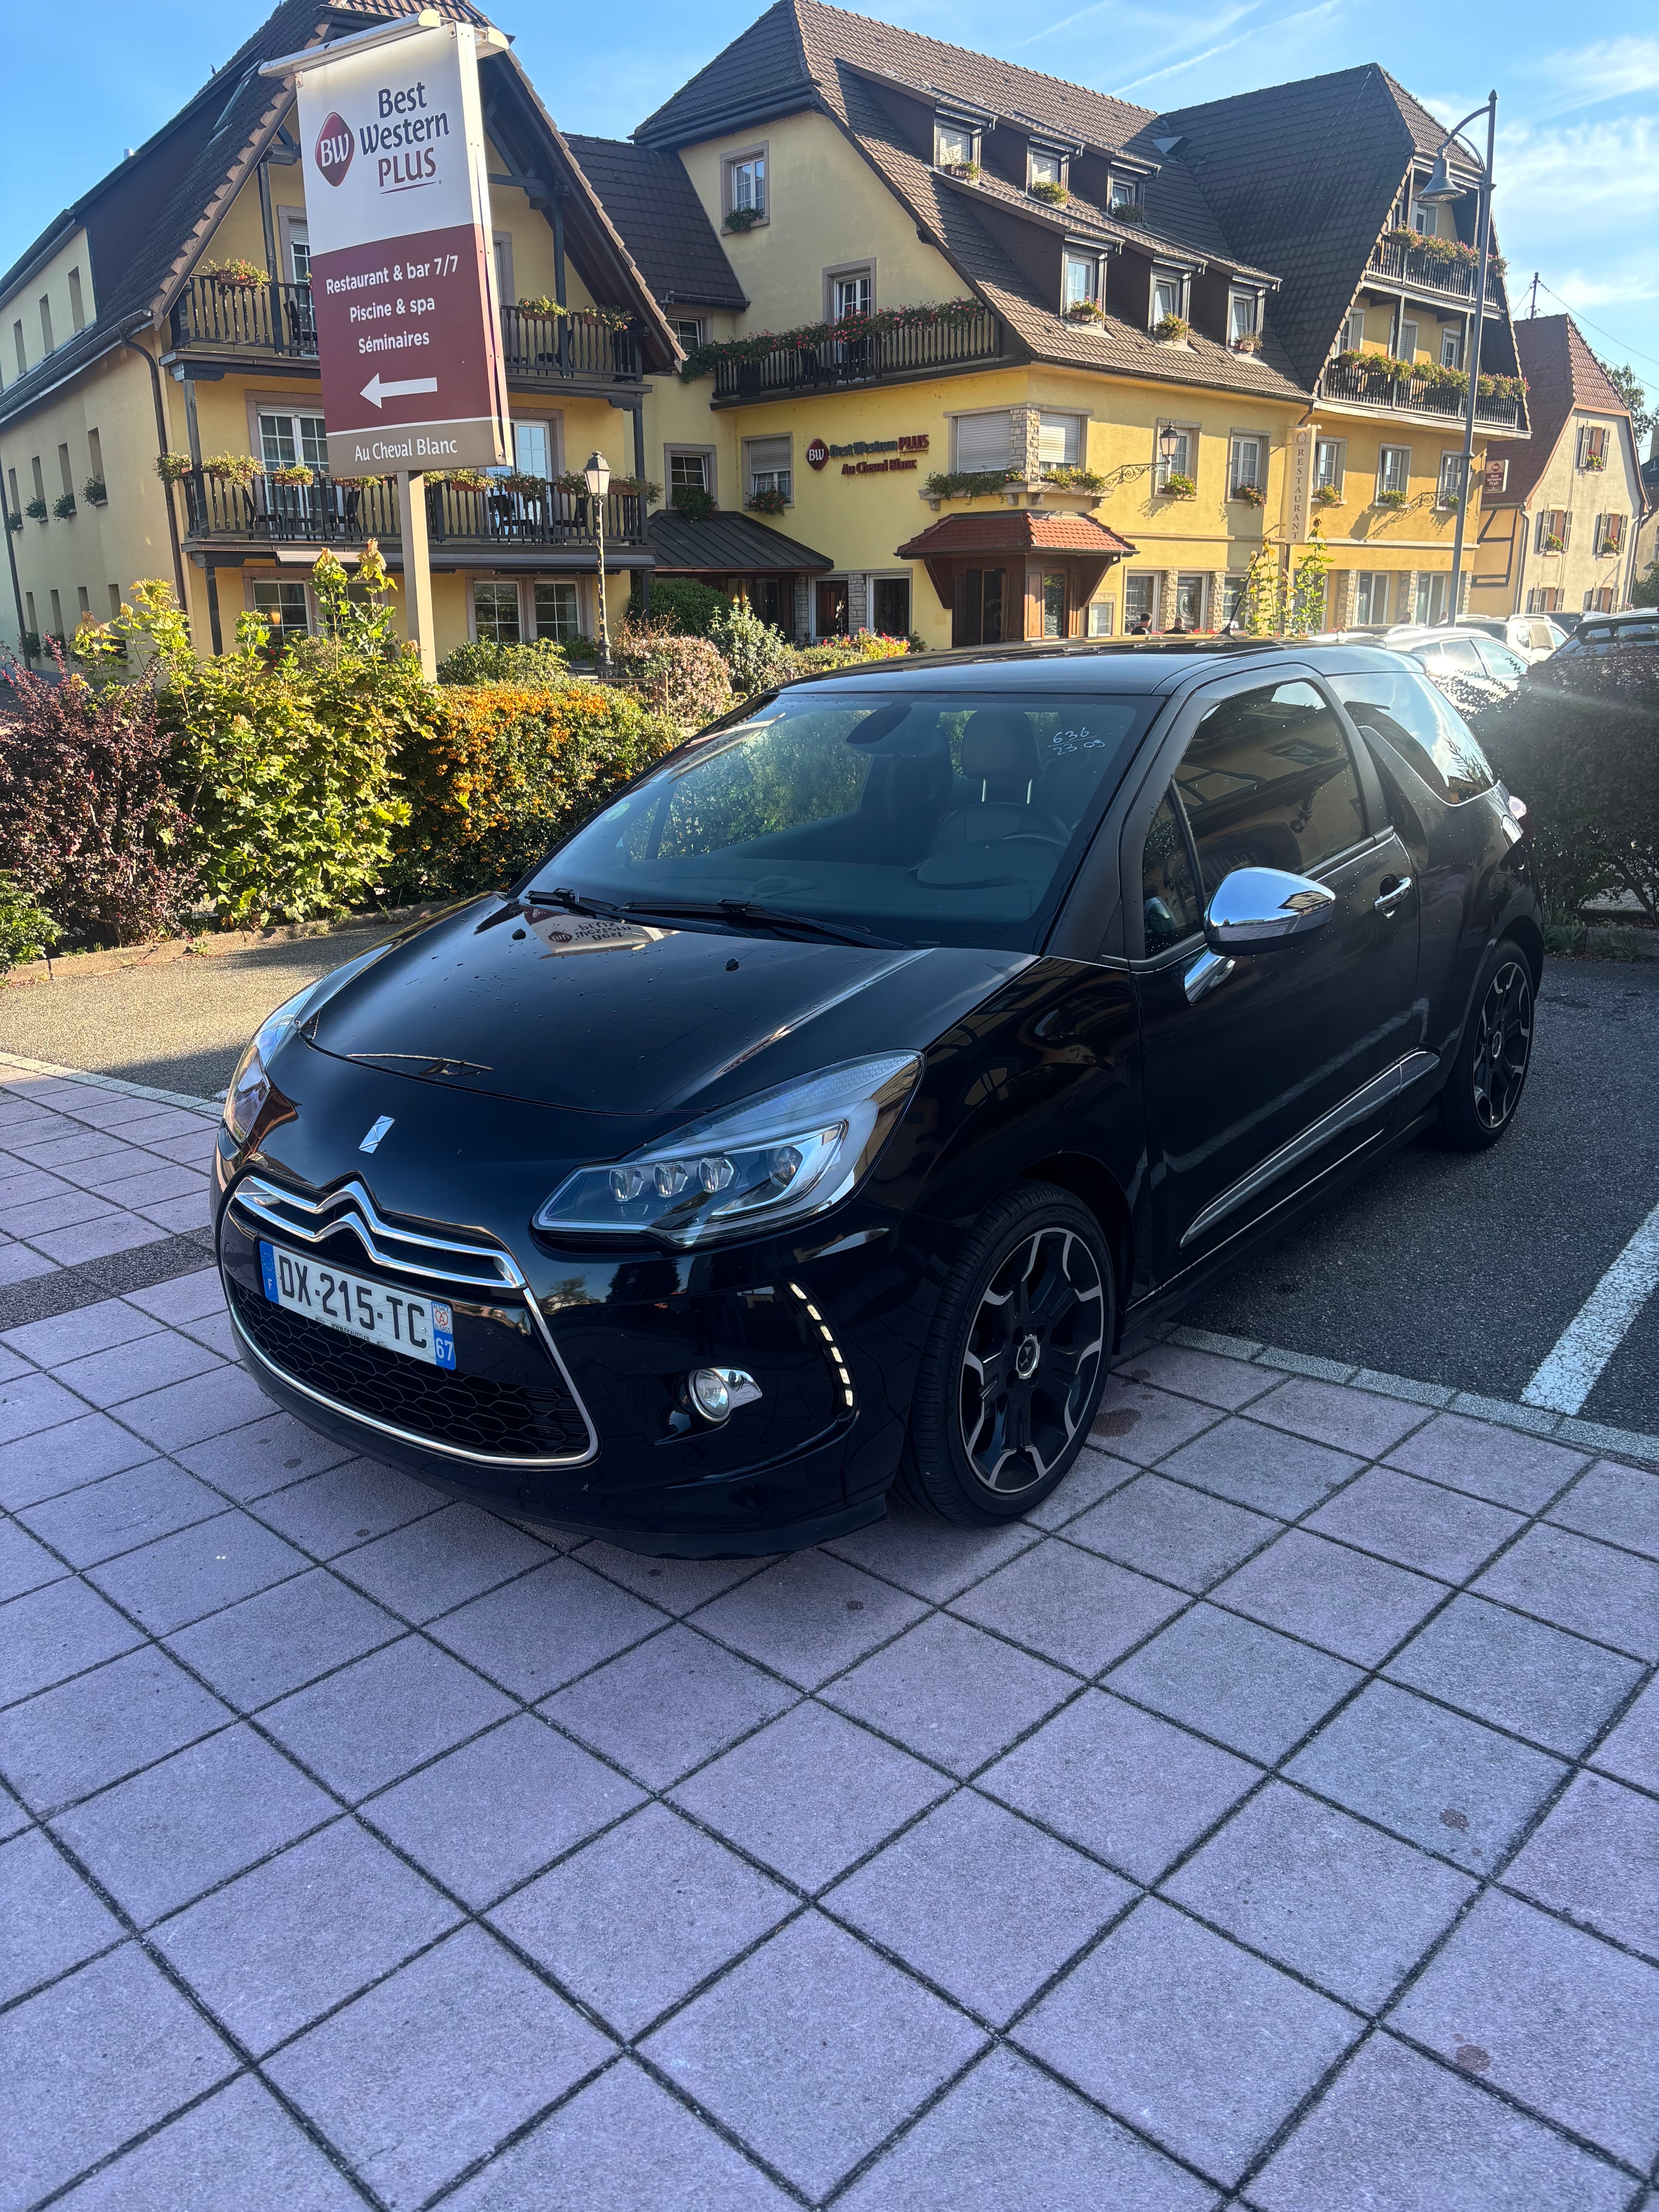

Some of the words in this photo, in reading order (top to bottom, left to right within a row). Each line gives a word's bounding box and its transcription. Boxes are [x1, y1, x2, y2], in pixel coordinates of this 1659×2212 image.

[378, 82, 427, 118] Best
[359, 112, 450, 155] Western
[320, 134, 349, 167] BW
[378, 147, 436, 187] PLUS
[326, 267, 389, 294] Restaurant
[393, 264, 403, 281] &
[407, 262, 431, 279] bar
[434, 254, 459, 276] 7/7
[350, 302, 392, 323] Piscine
[396, 298, 405, 315] &
[410, 297, 435, 315] spa
[358, 331, 430, 354] Séminaires
[355, 445, 370, 462] Au
[372, 439, 412, 460] Cheval
[416, 437, 458, 456] Blanc
[809, 448, 824, 461] BW
[829, 444, 854, 457] Best
[853, 440, 898, 455] Western
[898, 434, 929, 450] PLUS
[842, 464, 855, 475] Au
[856, 460, 888, 474] Cheval
[889, 459, 917, 471] Blanc
[1291, 449, 1304, 539] RESTAURANT
[1053, 727, 1089, 743] 636
[1053, 740, 1105, 755] 23.09
[268, 1278, 272, 1290] F
[279, 1255, 427, 1348] DX-215-TC
[433, 1304, 450, 1313] ALSACE
[435, 1324, 450, 1333] ELSASS
[436, 1337, 453, 1361] 67
